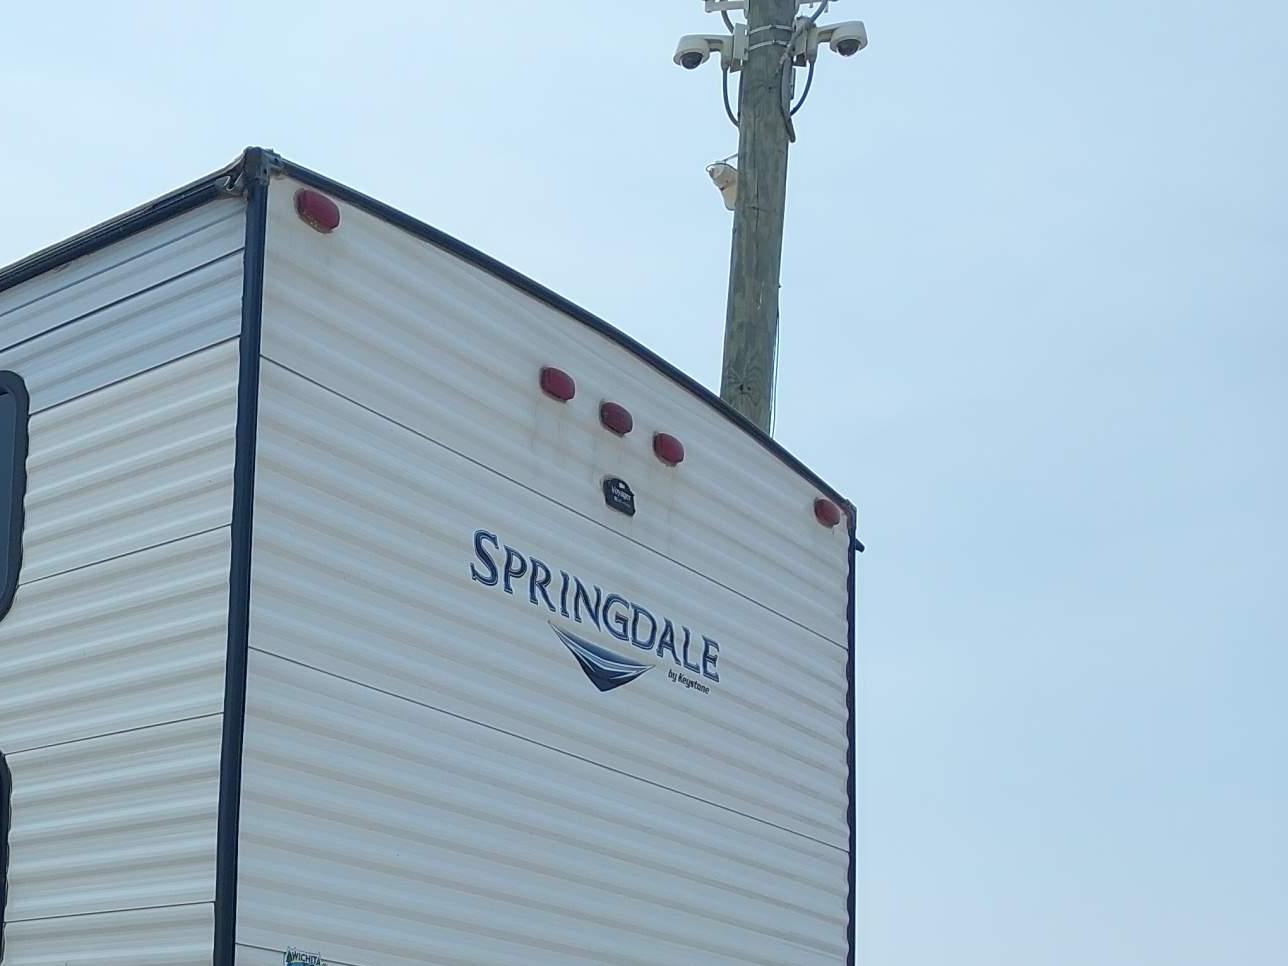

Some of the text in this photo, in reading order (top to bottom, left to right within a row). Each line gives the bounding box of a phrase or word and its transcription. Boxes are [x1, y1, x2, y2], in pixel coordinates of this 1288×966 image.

[667, 669, 711, 695] by Keystone
[292, 951, 320, 965] WICHITA
